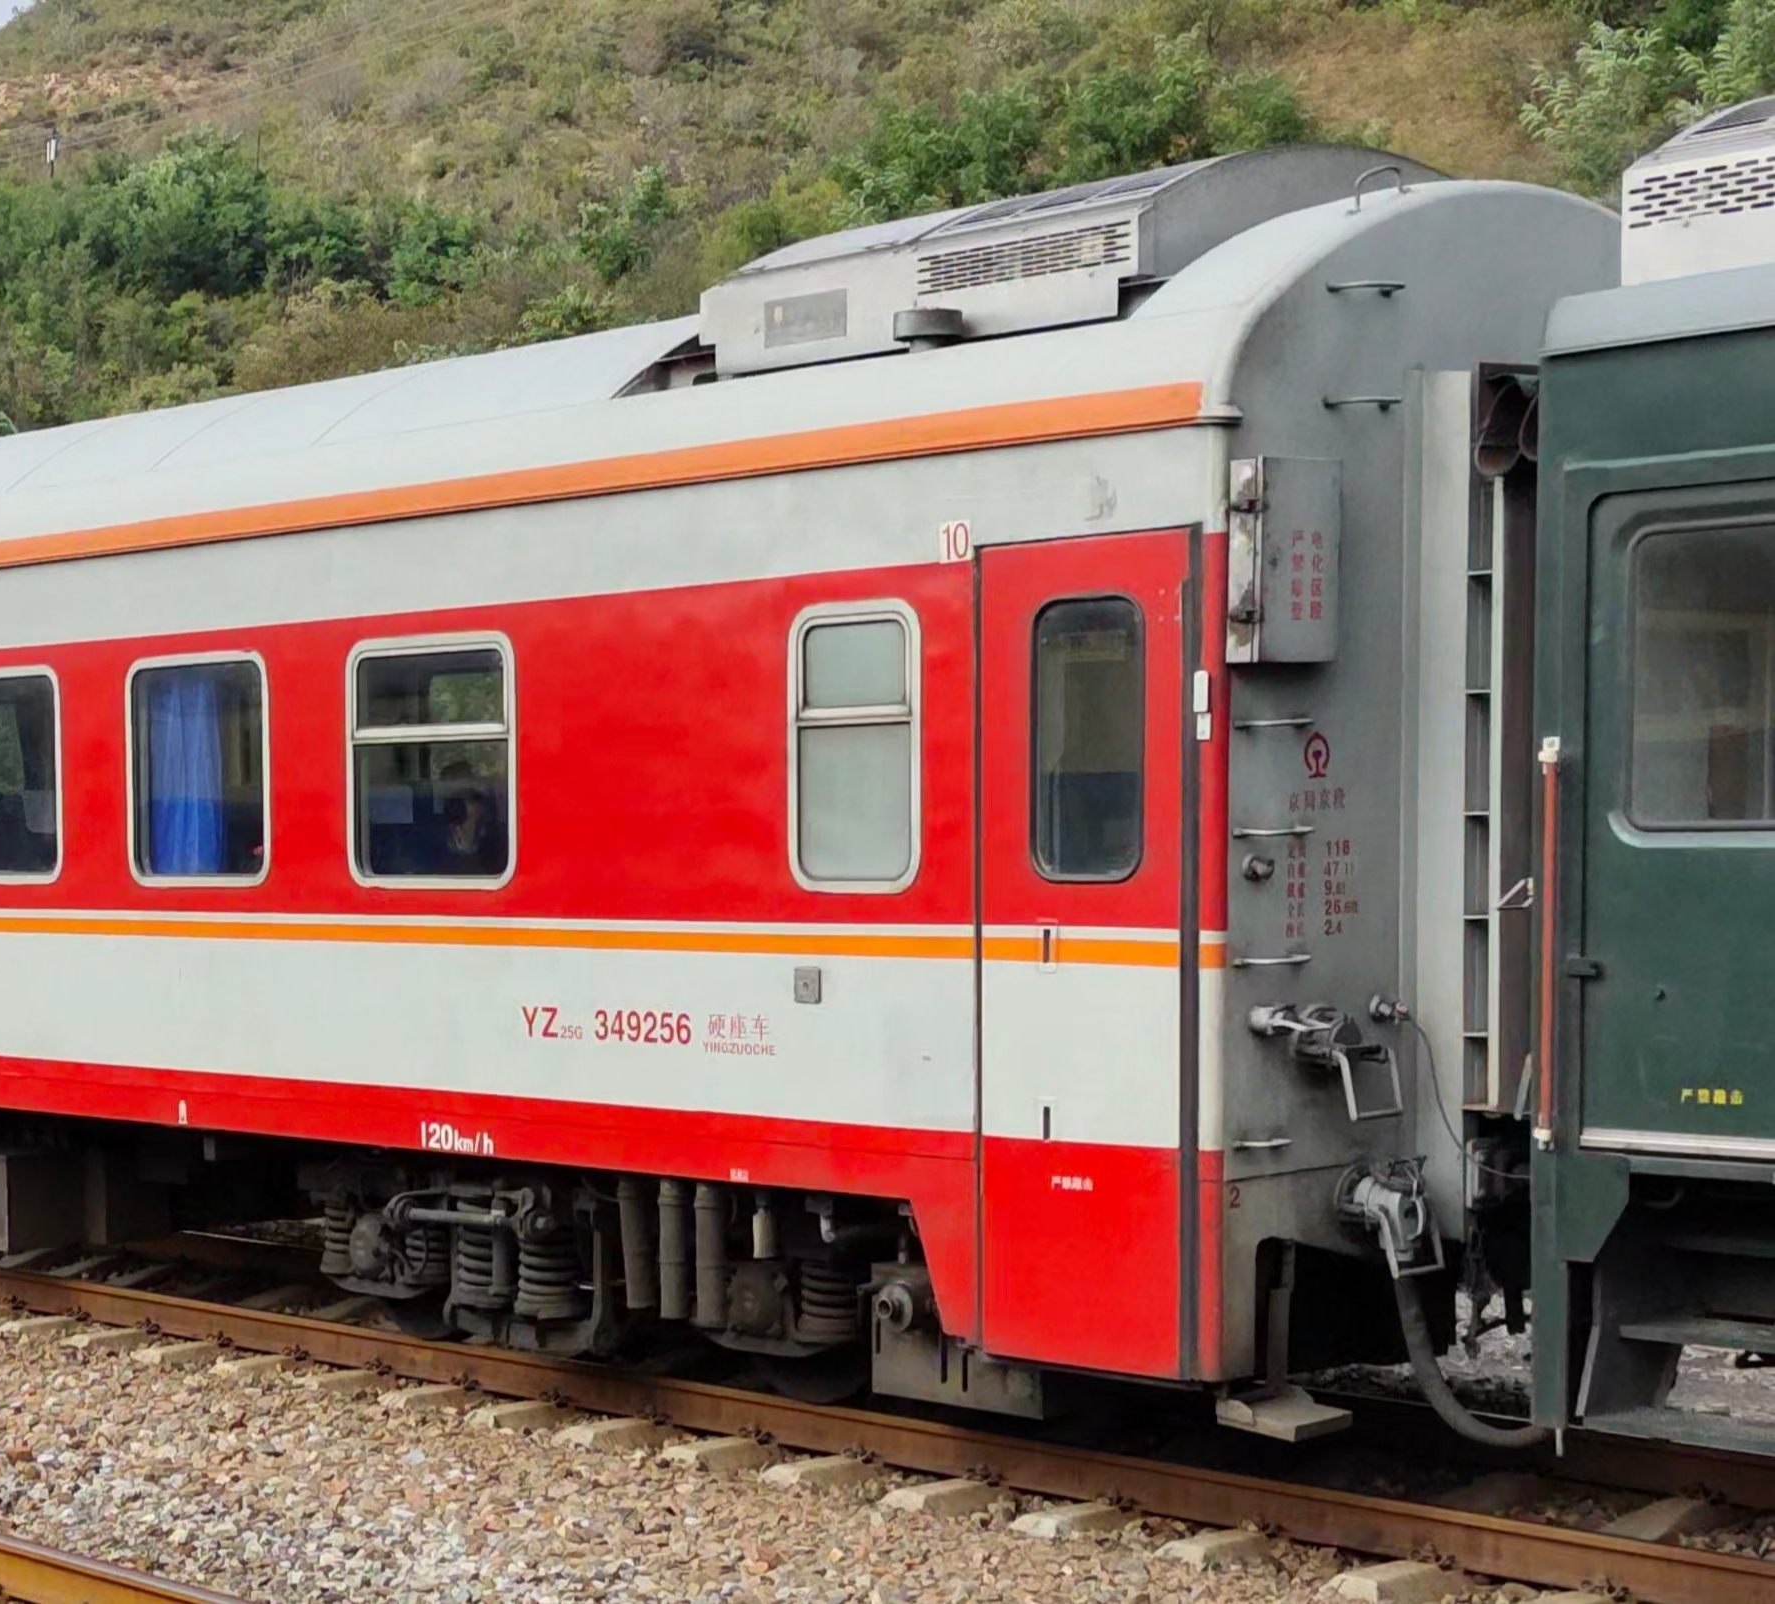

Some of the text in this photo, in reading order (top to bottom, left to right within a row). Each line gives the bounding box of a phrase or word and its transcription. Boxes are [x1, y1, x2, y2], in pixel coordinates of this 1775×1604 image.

[942, 522, 969, 560] 10
[594, 1009, 692, 1045] 349256
[707, 1013, 771, 1042] 硬座车
[702, 1041, 776, 1056] YINGZUOCHE
[420, 1121, 494, 1154] 120km/h
[1229, 1186, 1241, 1208] 2
